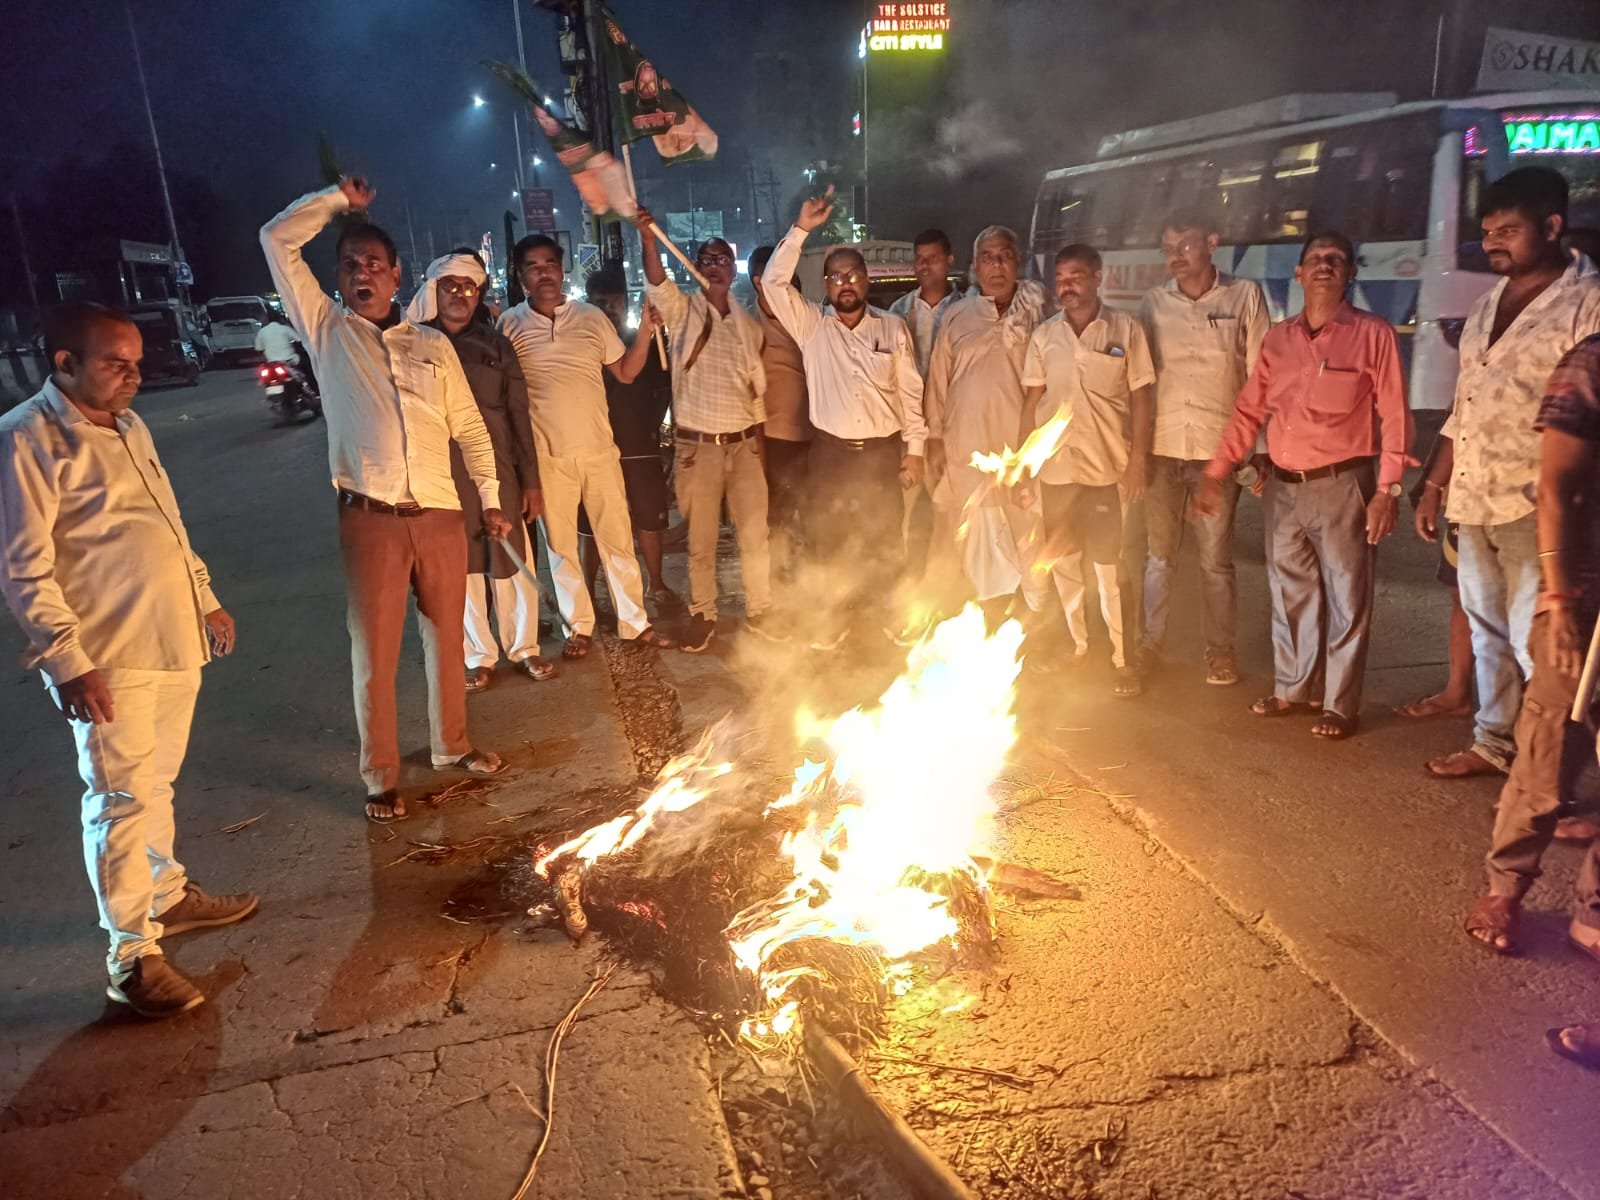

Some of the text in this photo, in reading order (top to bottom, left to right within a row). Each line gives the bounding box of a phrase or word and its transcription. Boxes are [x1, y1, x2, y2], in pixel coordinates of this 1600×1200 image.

[879, 3, 946, 16] THE SOLSTICE
[900, 19, 950, 31] RESTAURANT
[900, 34, 943, 50] STYLE
